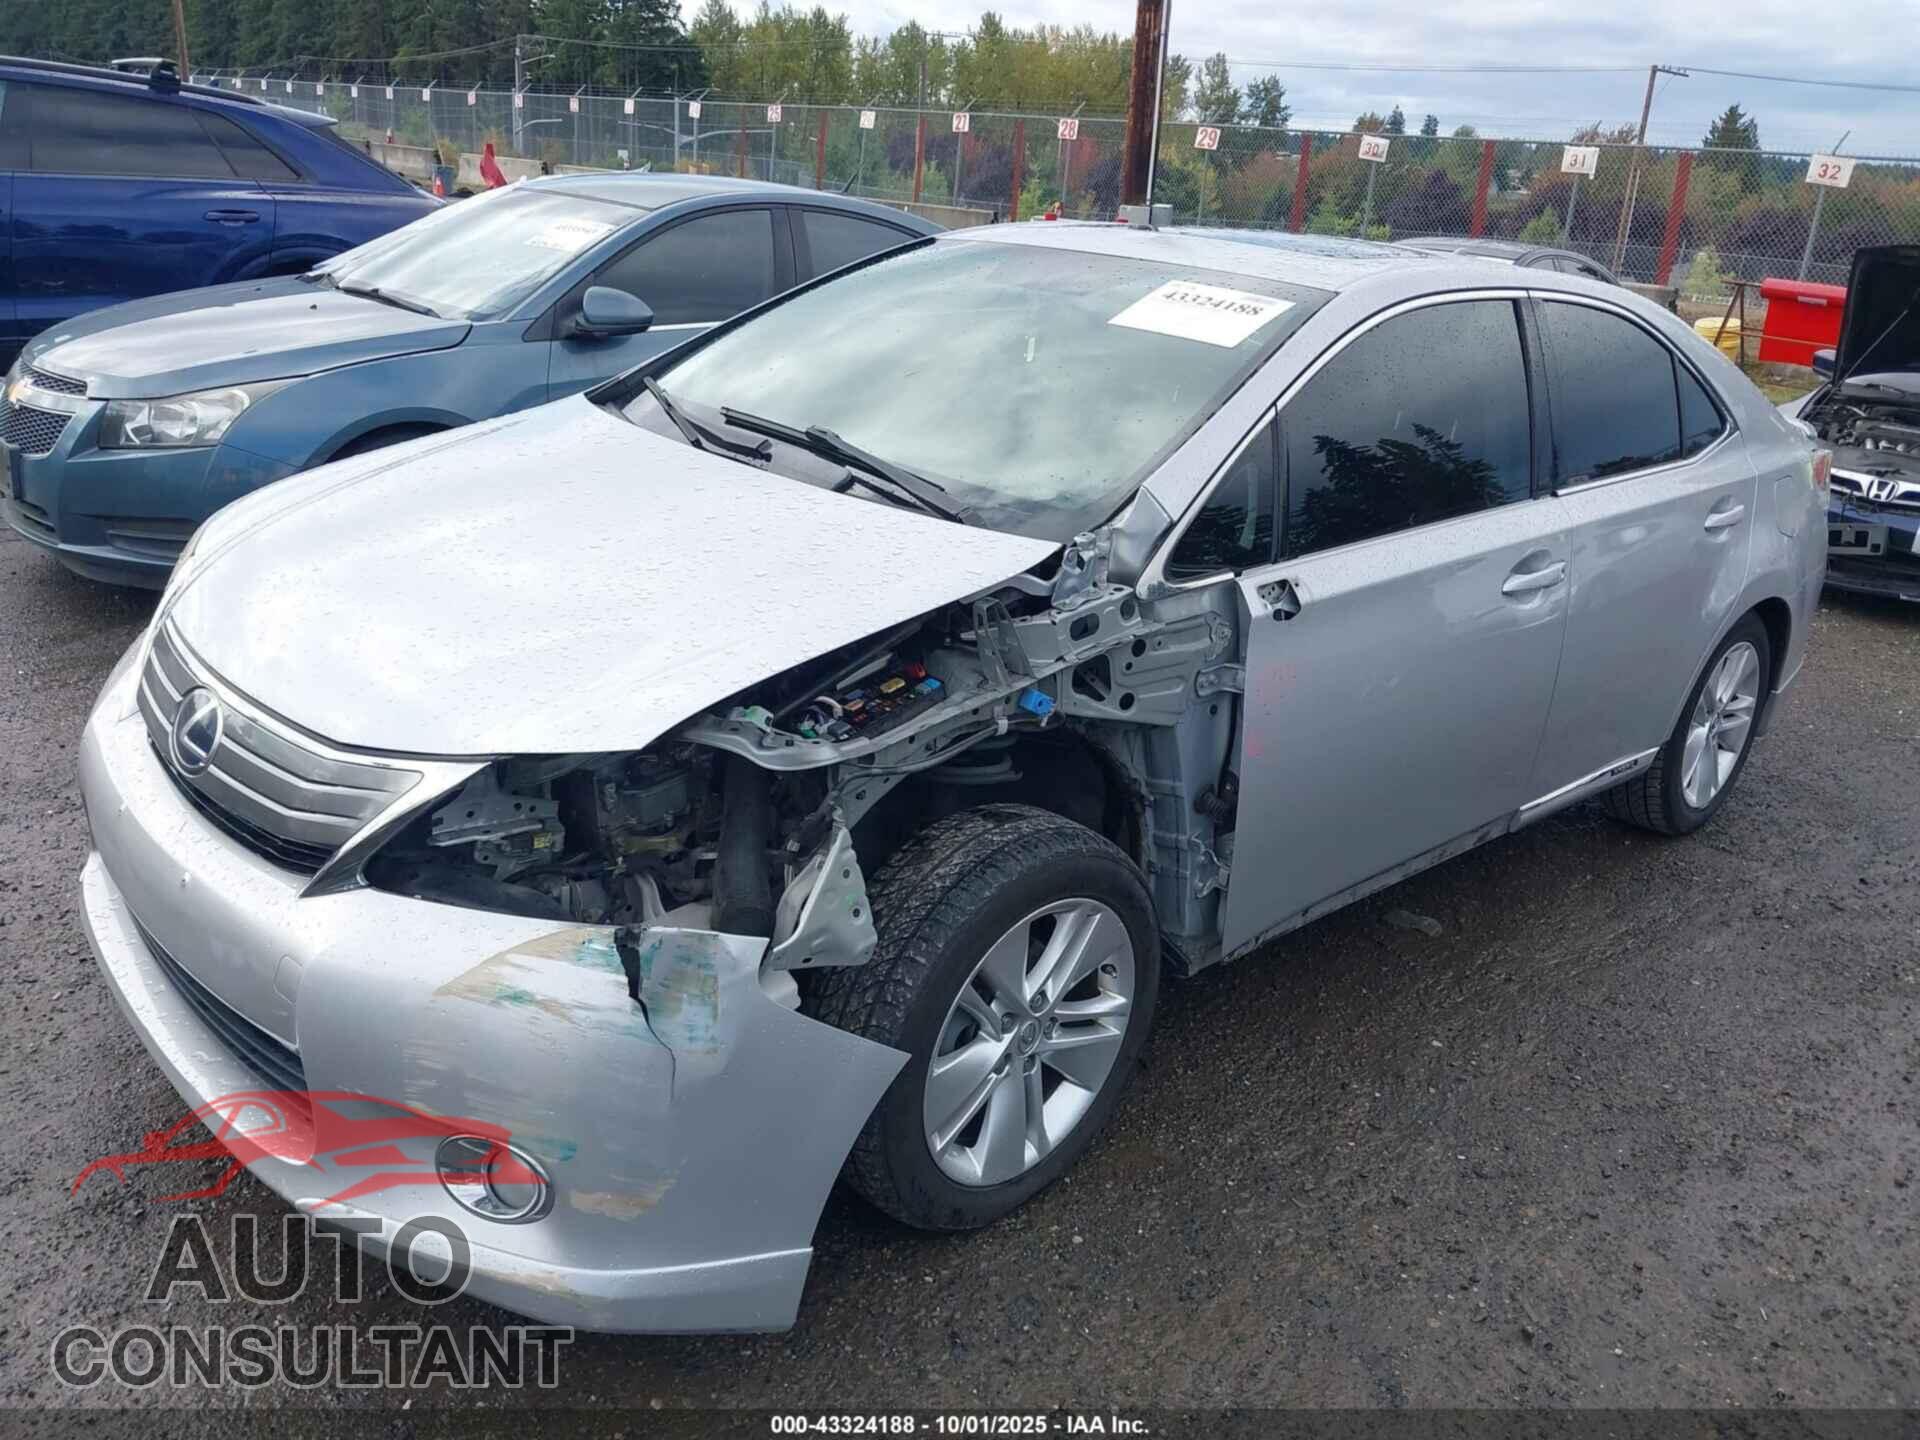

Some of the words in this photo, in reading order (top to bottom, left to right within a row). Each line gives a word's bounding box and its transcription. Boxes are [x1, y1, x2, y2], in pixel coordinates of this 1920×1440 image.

[768, 106, 781, 121] 25
[954, 114, 967, 130] 27
[1060, 121, 1076, 138] 28
[1198, 128, 1217, 148] 29
[1366, 142, 1379, 156] 30
[1569, 154, 1586, 168] 31
[1818, 163, 1841, 180] 32
[1163, 291, 1264, 315] 43324188
